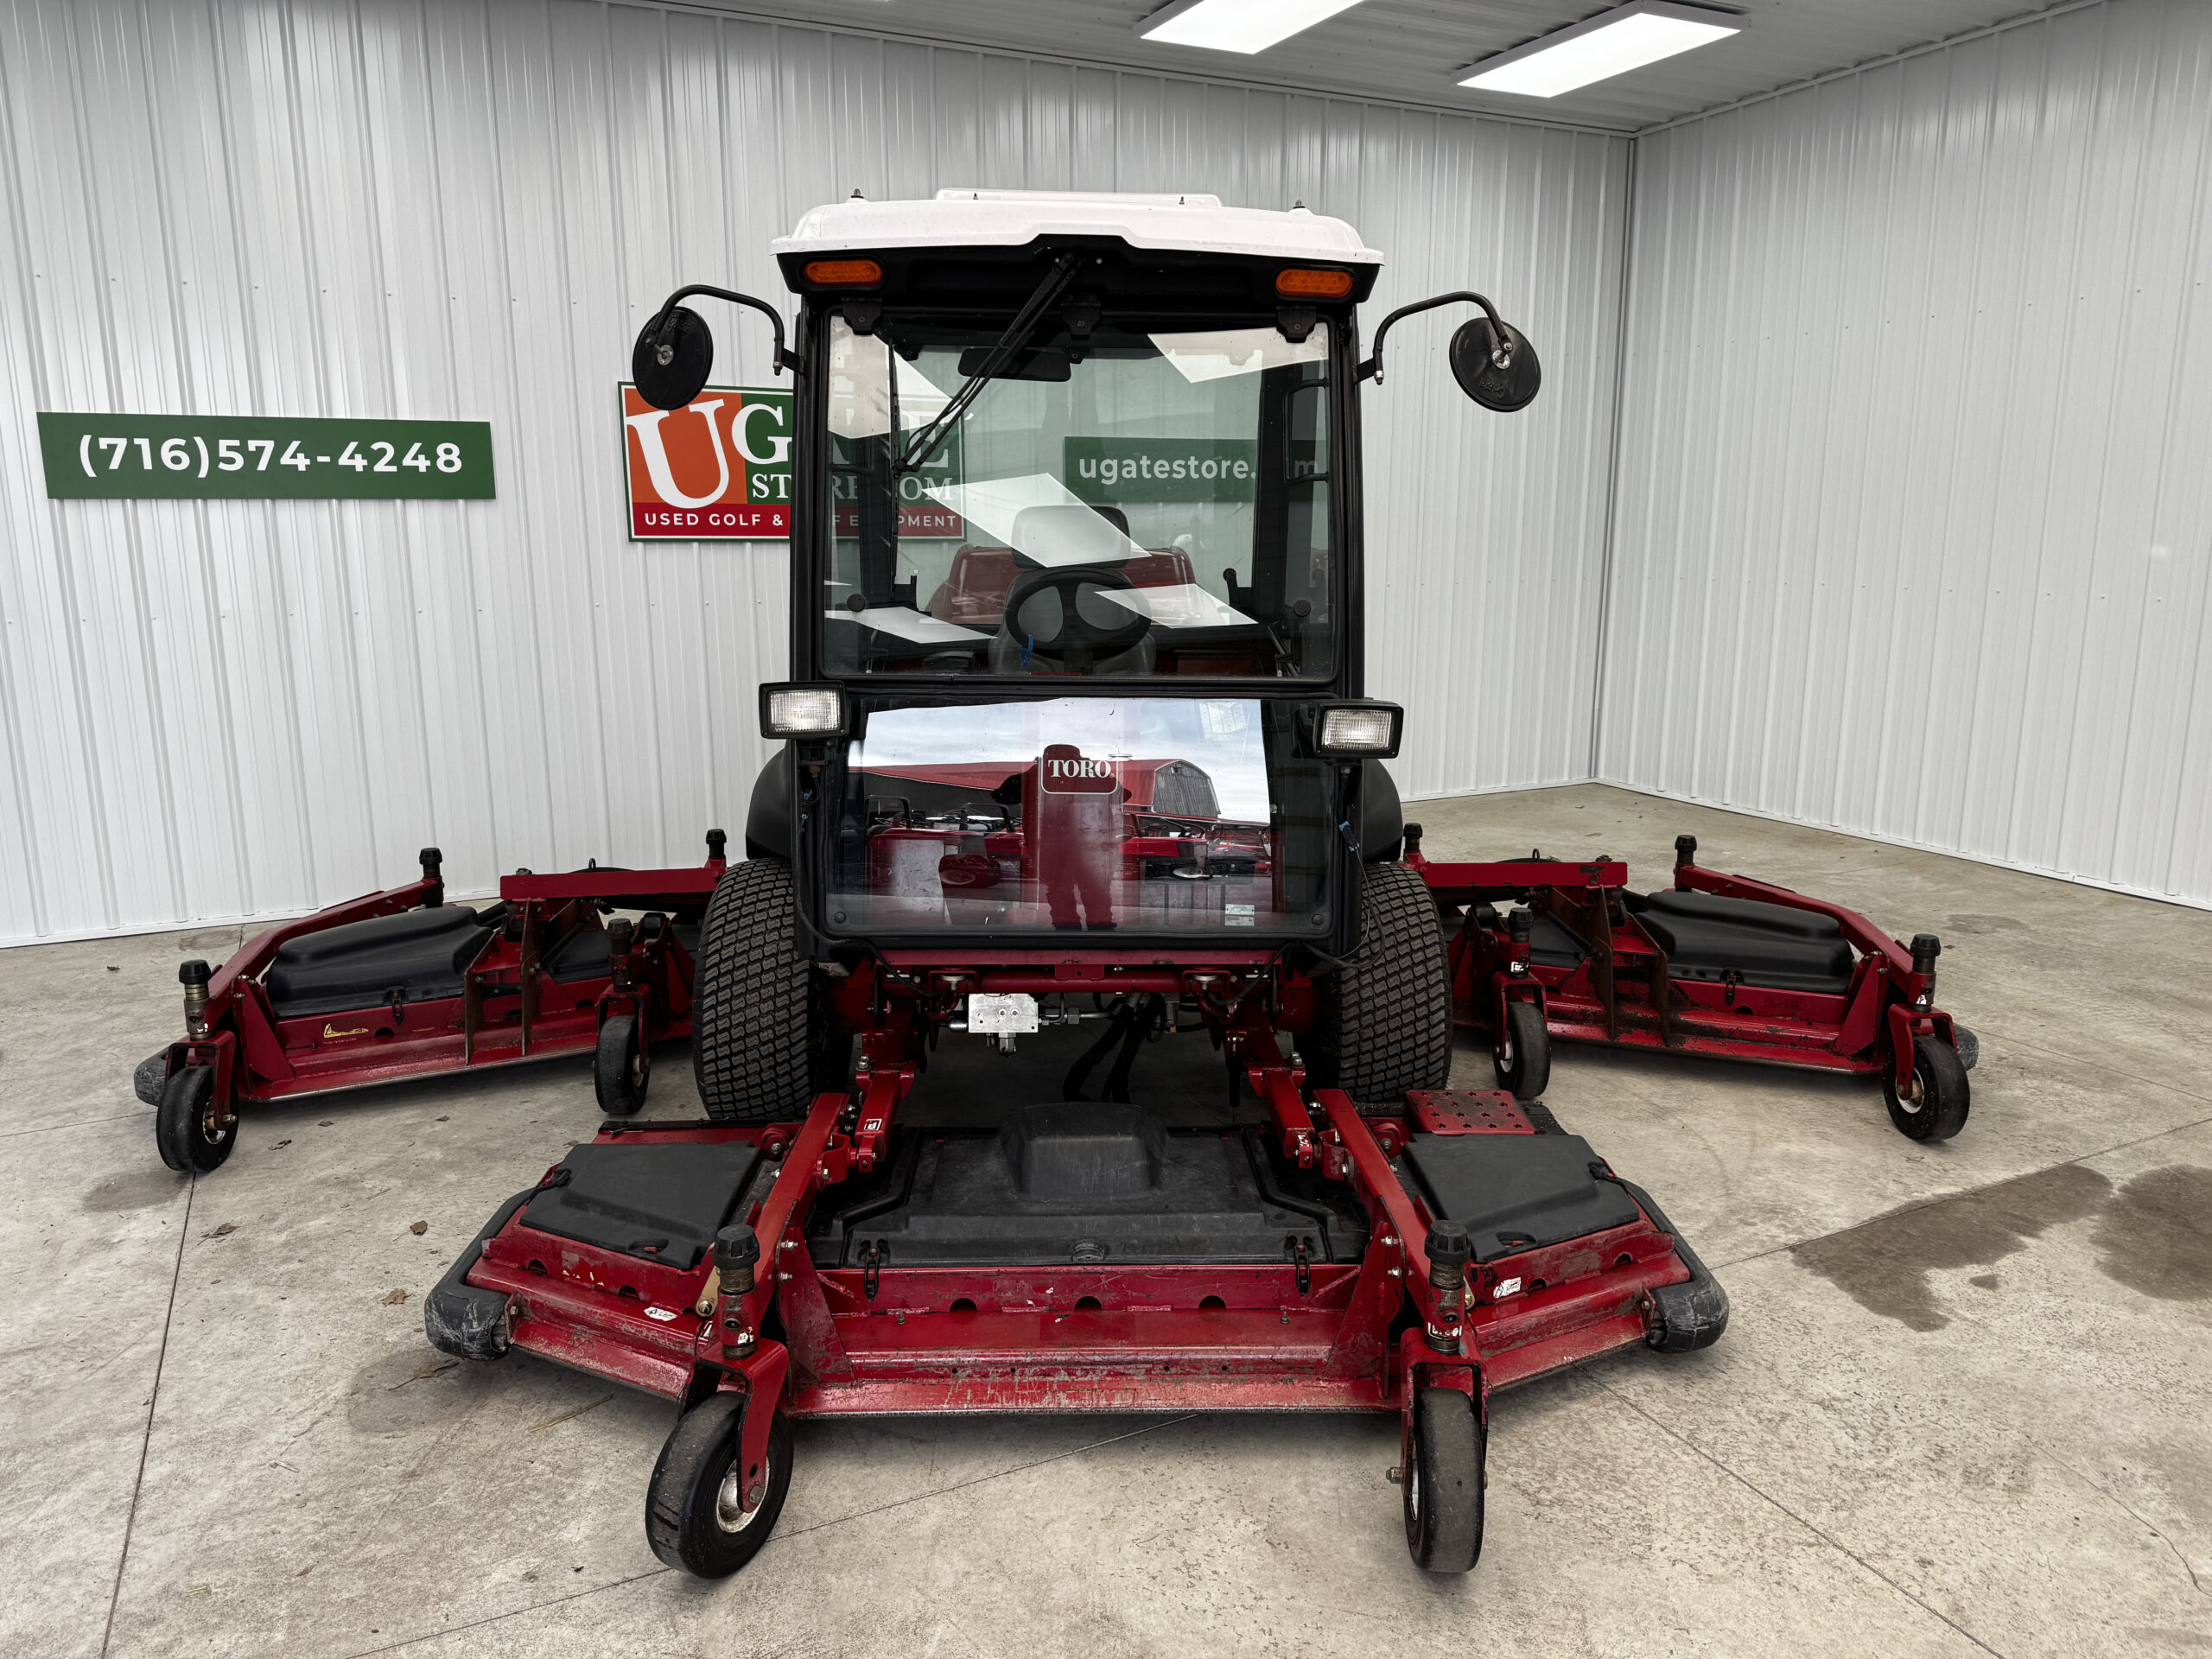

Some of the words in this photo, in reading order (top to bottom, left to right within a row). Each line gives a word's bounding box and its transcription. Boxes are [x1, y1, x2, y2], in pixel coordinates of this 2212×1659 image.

[79, 435, 462, 478] (716)574-4248
[1079, 455, 1319, 485] ugatestore.m
[645, 512, 699, 526] USED
[709, 513, 761, 526] GOLF
[772, 514, 784, 526] &
[1047, 760, 1111, 779] TORO
